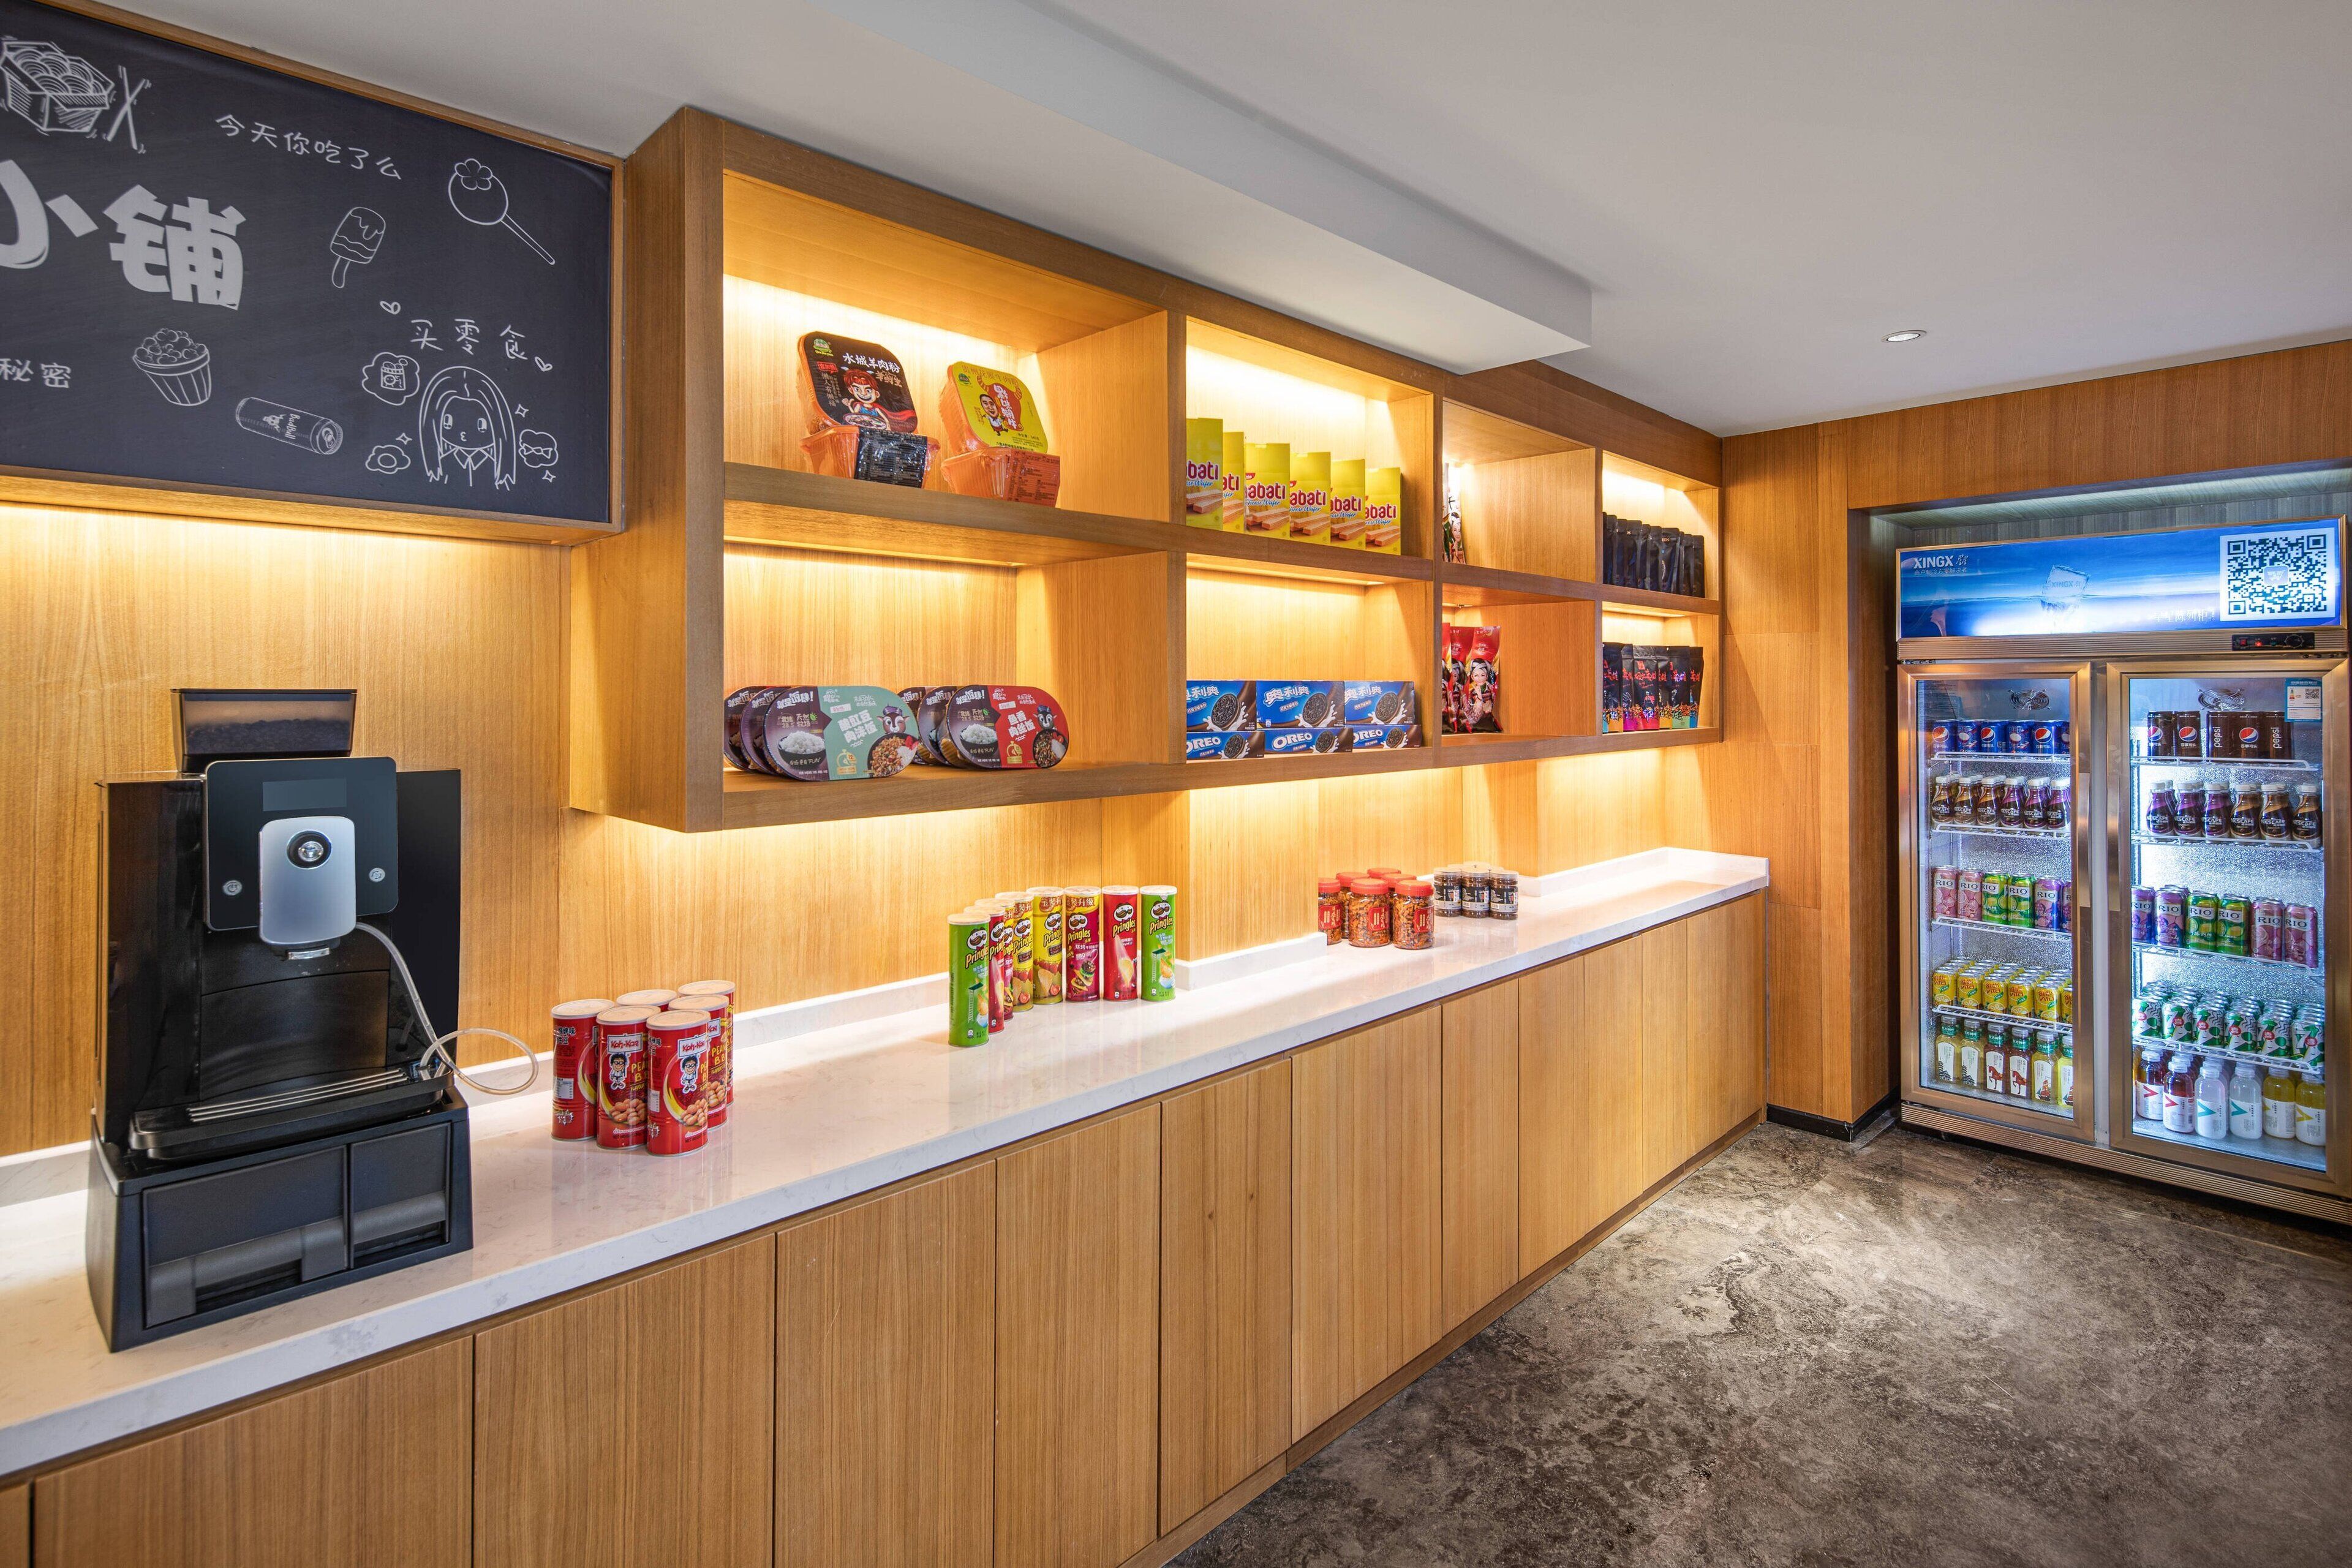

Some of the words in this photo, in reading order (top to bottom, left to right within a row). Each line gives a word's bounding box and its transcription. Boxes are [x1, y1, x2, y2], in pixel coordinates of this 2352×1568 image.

[216, 115, 401, 179] 今天你吃了么
[411, 318, 528, 360] 买零食
[842, 352, 900, 373] 水城羊肉粉
[1913, 555, 1954, 568] XINGX
[1265, 685, 1310, 704] 奥利奥
[1273, 733, 1313, 748] OREO
[2213, 726, 2223, 748] pepsi
[2272, 727, 2282, 748] pepsi
[2132, 901, 2150, 910] RIO
[2190, 908, 2212, 916] RIO
[2219, 910, 2240, 919] RIO
[1112, 919, 1136, 938] Pringles
[1150, 917, 1173, 935] Pringles
[2285, 919, 2307, 928] RIO
[1068, 928, 1090, 944] Pringles
